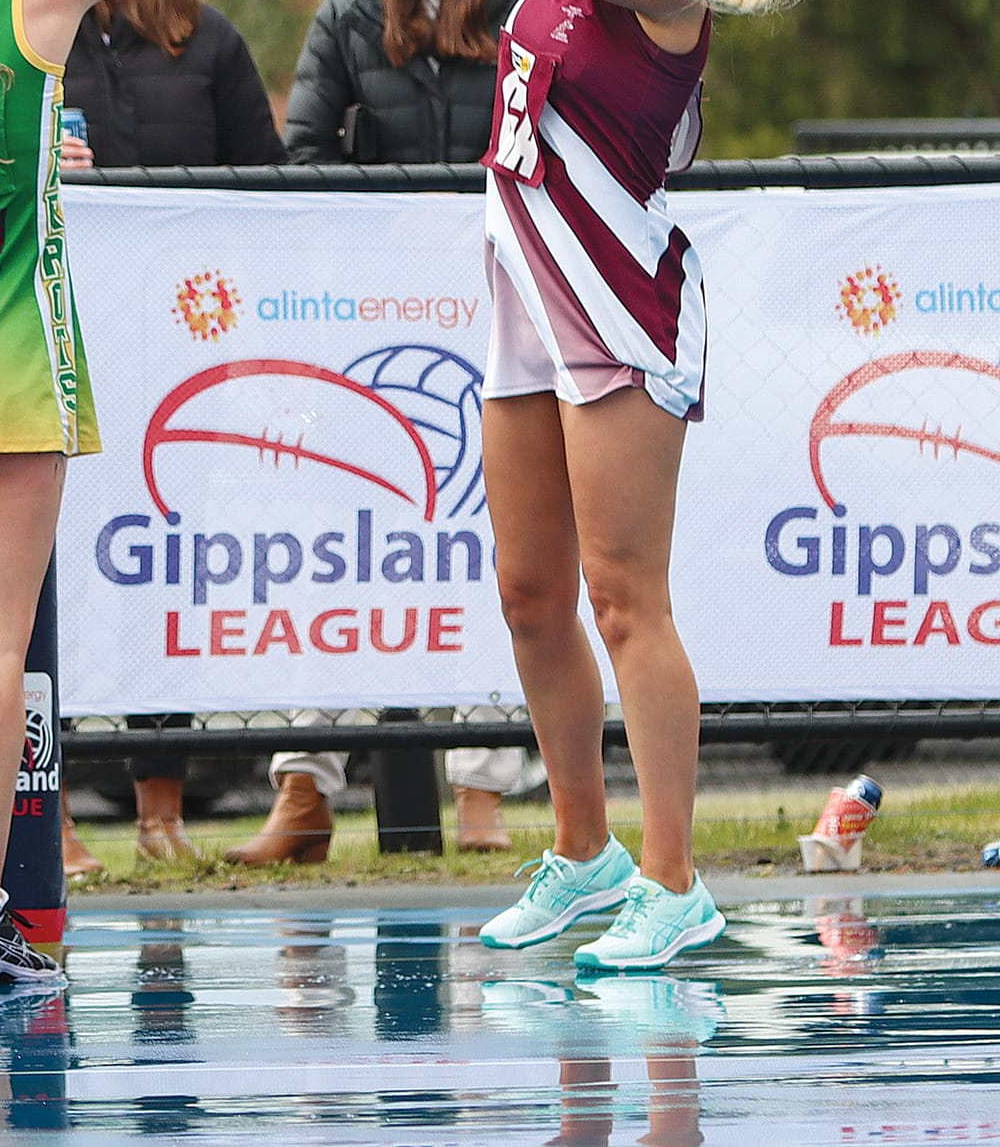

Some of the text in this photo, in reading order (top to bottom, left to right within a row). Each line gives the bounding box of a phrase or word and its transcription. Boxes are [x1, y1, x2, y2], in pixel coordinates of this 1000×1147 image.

[257, 290, 480, 330] alintaenergy
[95, 508, 497, 606] Gippslan
[165, 607, 465, 658] LEAGUE
